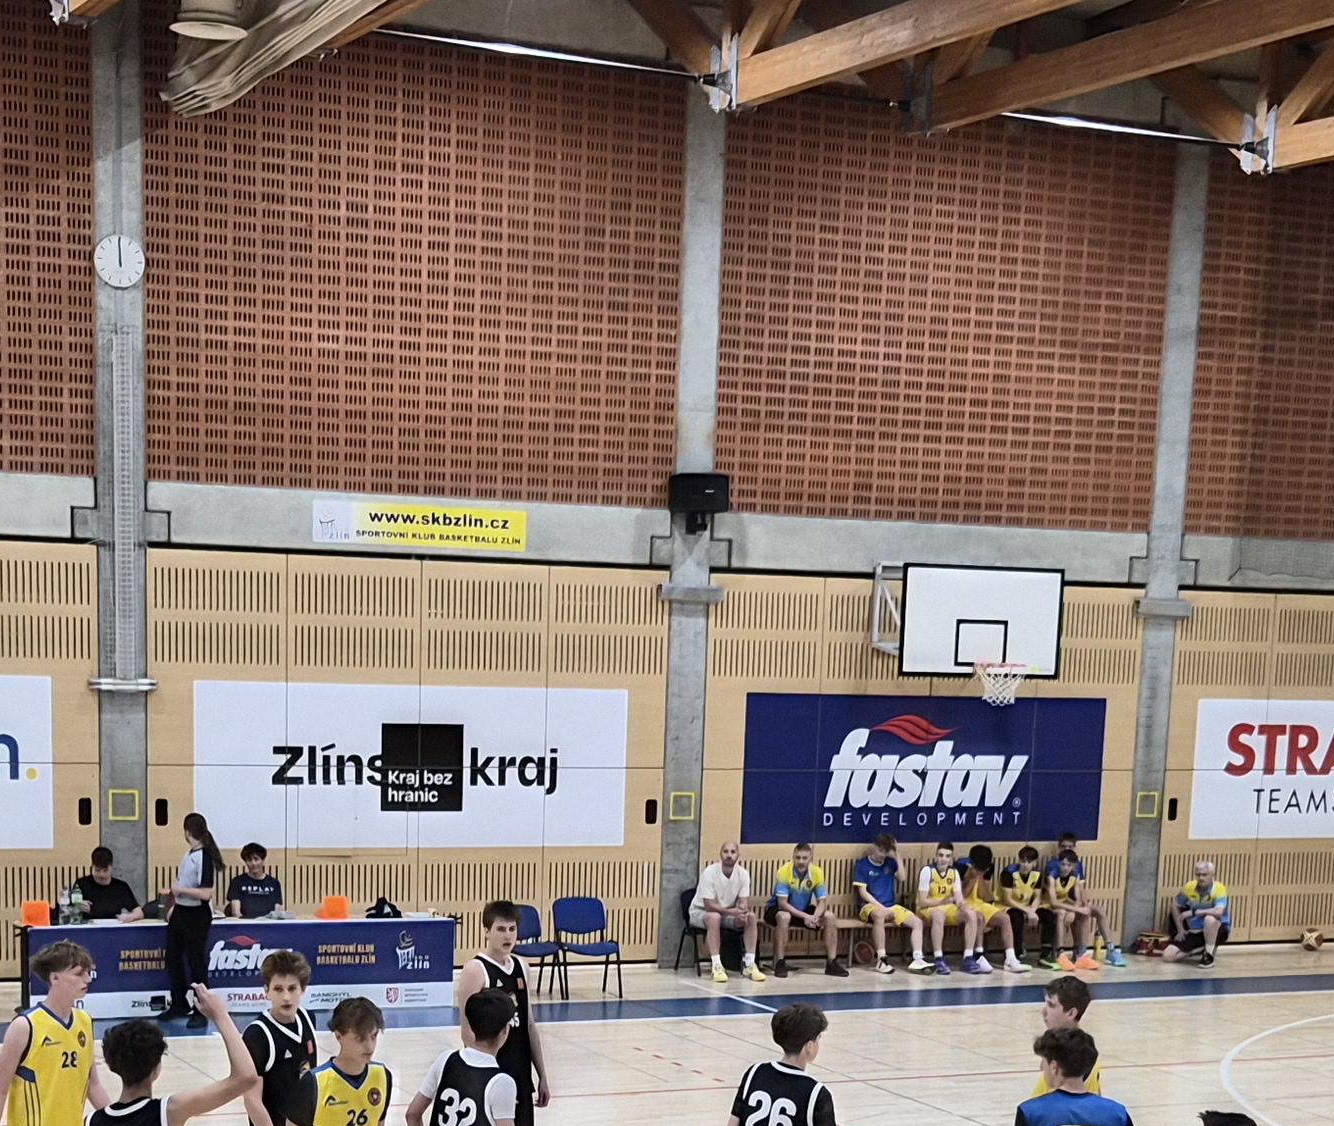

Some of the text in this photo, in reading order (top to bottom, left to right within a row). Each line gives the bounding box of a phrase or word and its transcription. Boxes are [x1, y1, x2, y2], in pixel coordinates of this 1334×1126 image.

[368, 512, 510, 530] www.skbzlin.cz
[355, 529, 521, 545] SPORTOVNÍ KLUB BASKETBALU ZLÍN
[469, 747, 559, 796] kraj
[823, 728, 1029, 808] fastav
[387, 769, 454, 788] Kraj bez
[387, 787, 439, 803] hranic
[822, 811, 1021, 827] DEVELOPMENT
[208, 940, 294, 971] fast
[60, 1050, 78, 1070] 28
